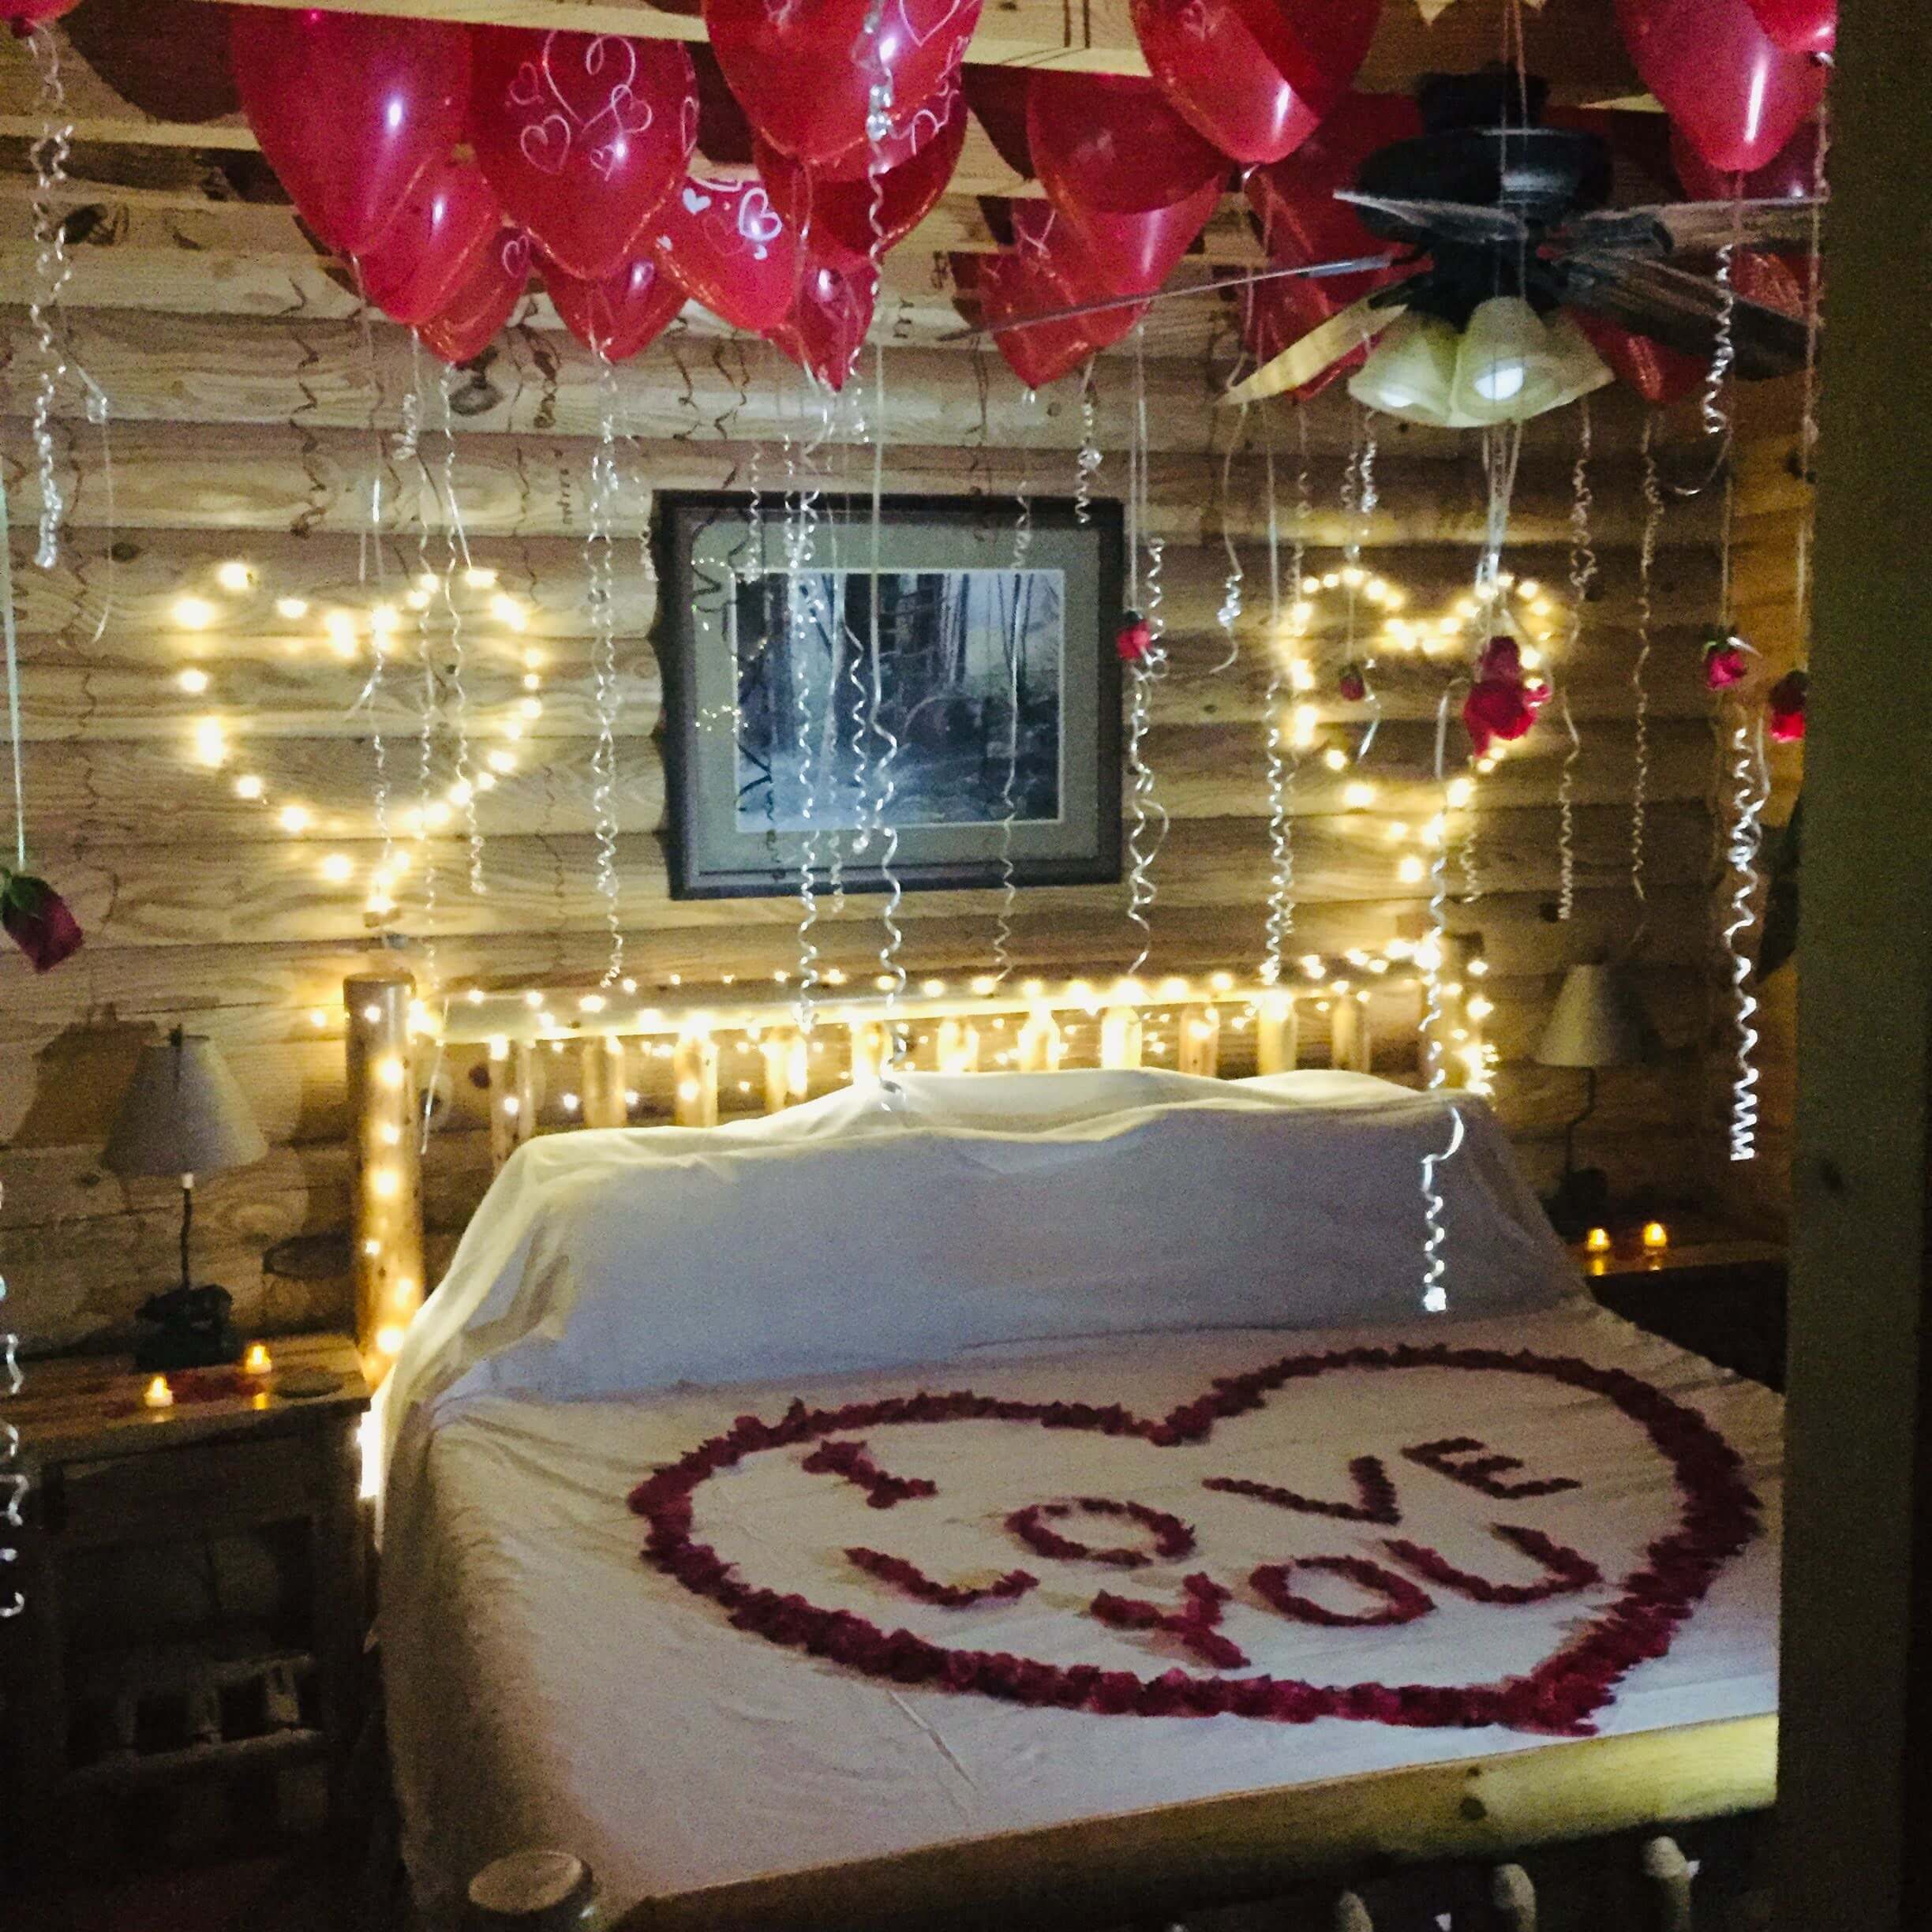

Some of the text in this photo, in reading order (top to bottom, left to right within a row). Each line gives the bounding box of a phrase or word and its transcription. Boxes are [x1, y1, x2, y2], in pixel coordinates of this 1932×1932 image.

[803, 1440, 936, 1508] I
[844, 1437, 1582, 1605] LOVE
[1092, 1525, 1599, 1668] YOU
